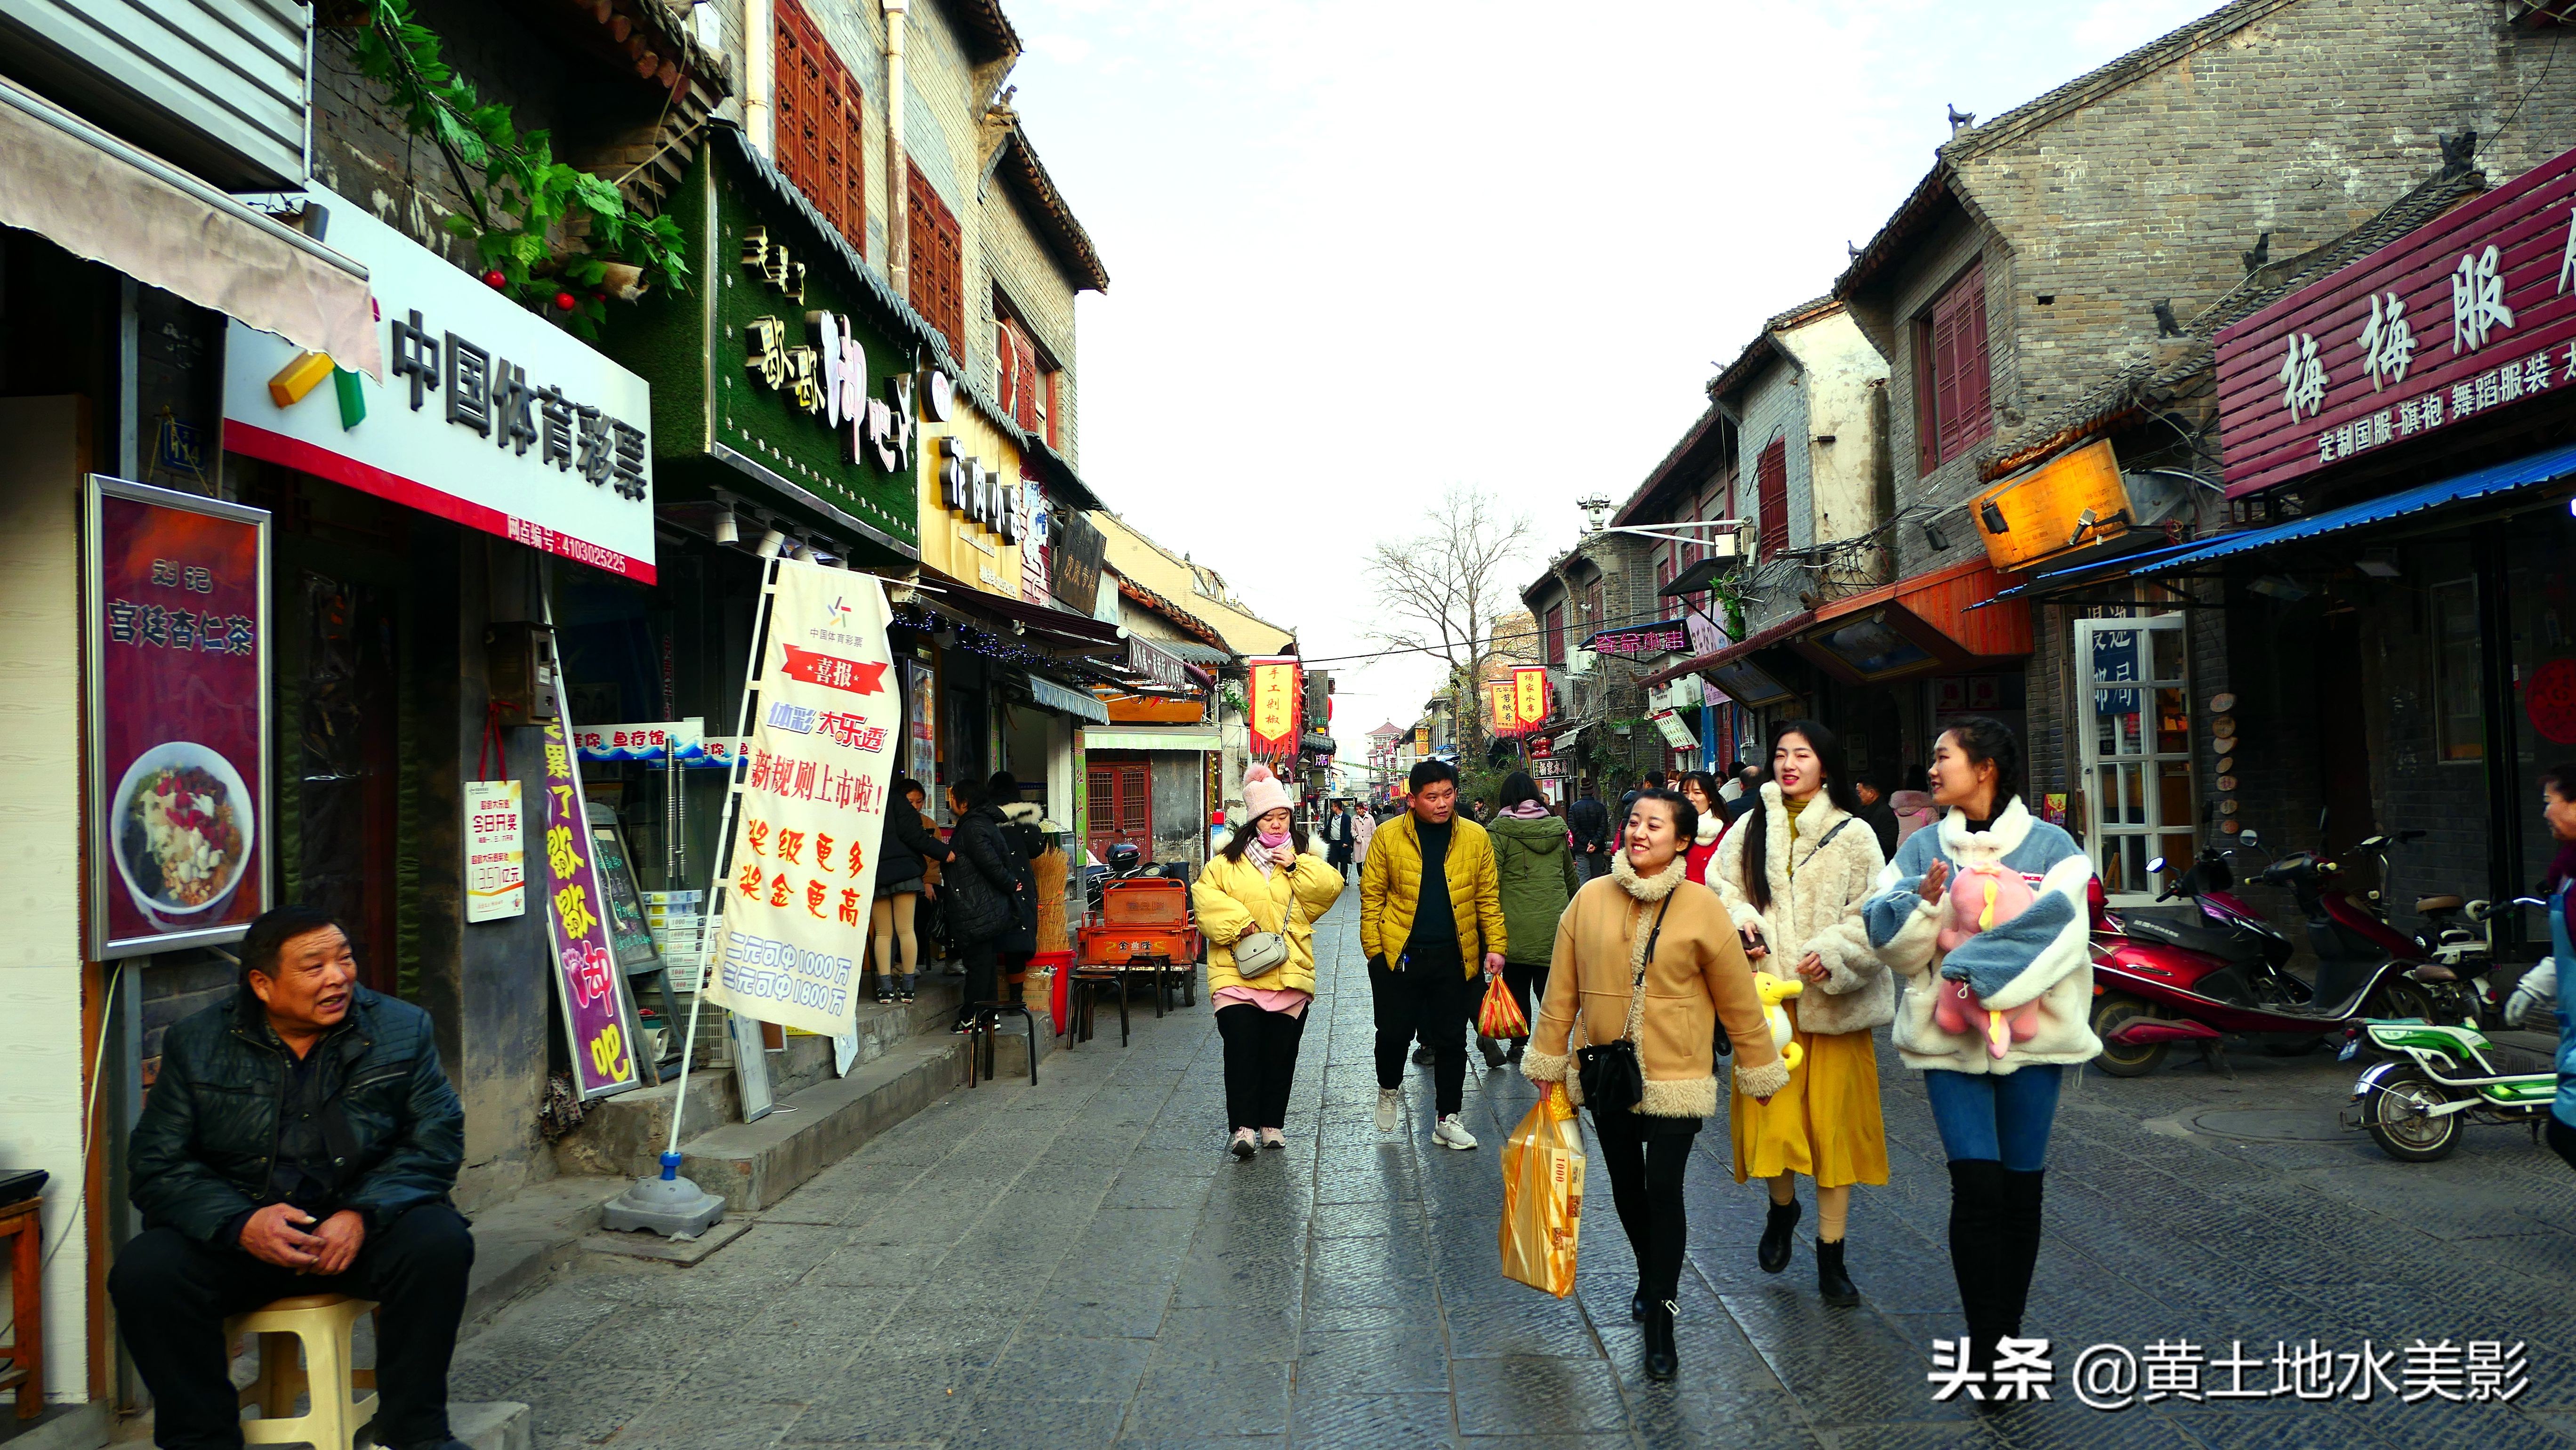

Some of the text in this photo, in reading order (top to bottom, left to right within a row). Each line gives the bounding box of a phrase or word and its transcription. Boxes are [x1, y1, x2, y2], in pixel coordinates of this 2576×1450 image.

[392, 308, 646, 502] 中国体育彩票
[2452, 353, 2553, 420] 舞蹈服装
[152, 558, 213, 594] 刘记
[107, 598, 254, 656] 宫廷杏仁茶
[810, 628, 863, 648] 中国体育彩票
[814, 658, 851, 688] 喜报
[1265, 667, 1280, 725] 手工剁椒
[767, 701, 816, 734] 体彩
[816, 710, 889, 753] 大乐透
[473, 814, 517, 833] 今日开奖
[749, 819, 864, 878] 奖级更多
[739, 864, 861, 927] 奖金更高
[725, 931, 852, 986] 二元可中1000万
[723, 961, 846, 1016] 三元可中1800万
[1555, 1158, 1565, 1182] 1000
